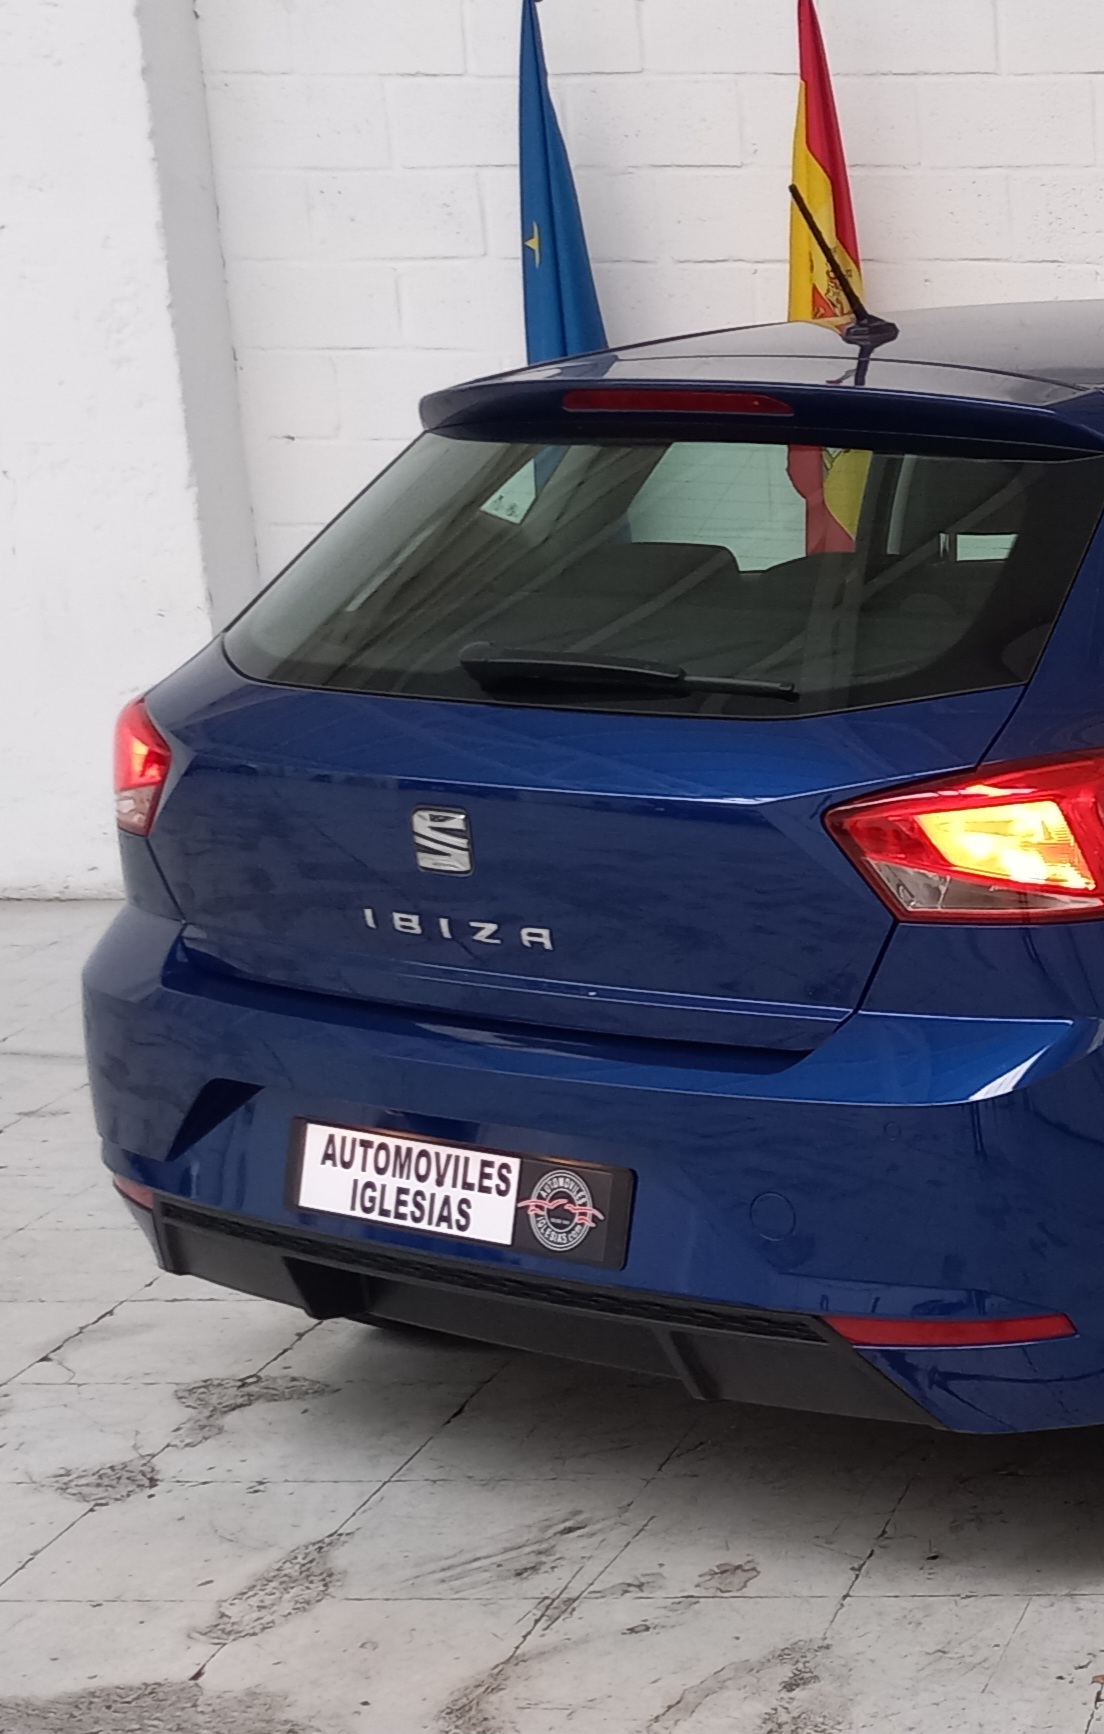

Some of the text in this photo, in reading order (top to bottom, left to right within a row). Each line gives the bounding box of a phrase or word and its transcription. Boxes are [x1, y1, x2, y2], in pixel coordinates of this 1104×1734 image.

[363, 908, 553, 951] IBIZA
[320, 1133, 513, 1198] AUTOMOVILES
[350, 1179, 473, 1233] IGLESIAS
[540, 1177, 587, 1204] AUTOMOVILES
